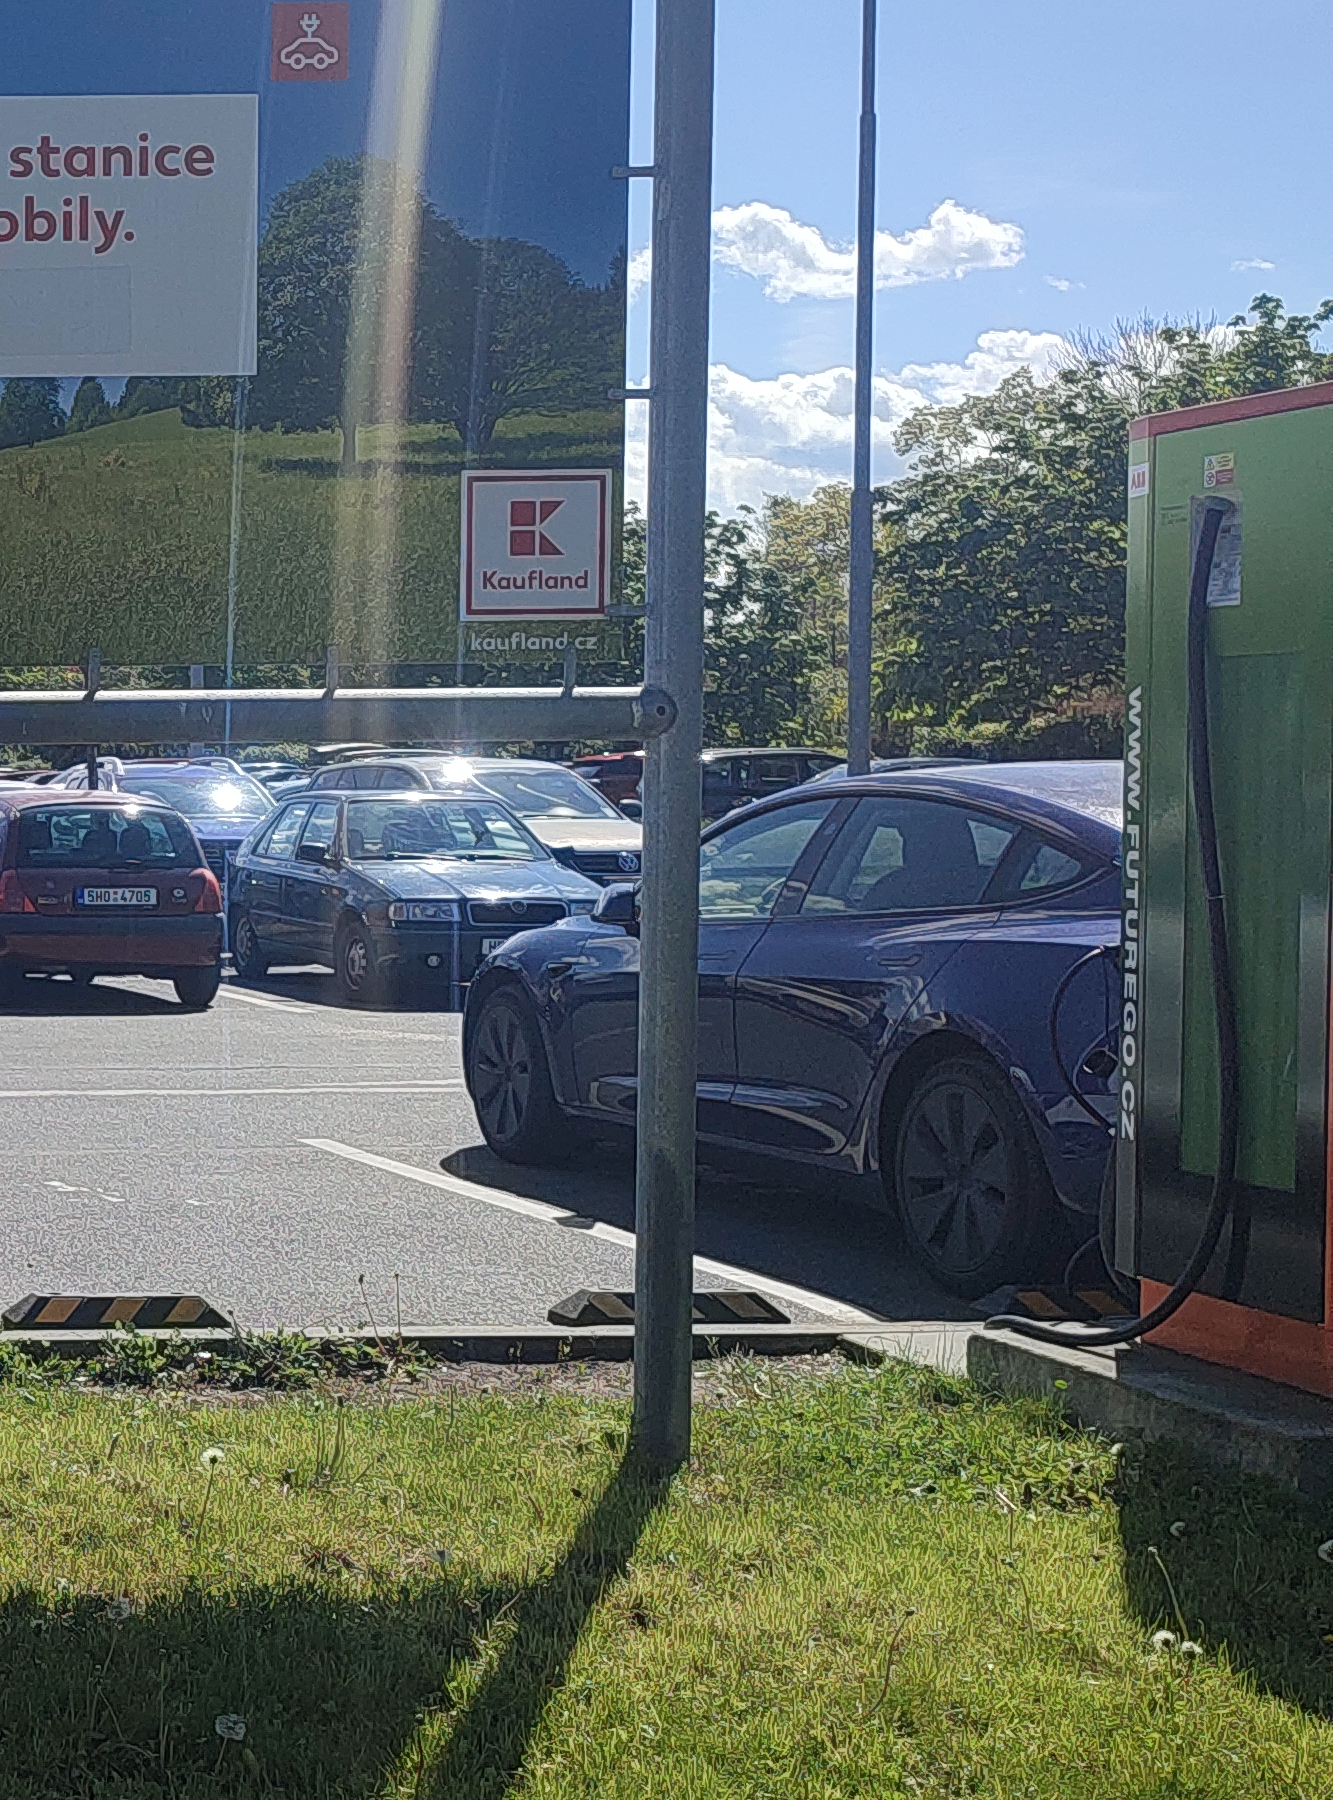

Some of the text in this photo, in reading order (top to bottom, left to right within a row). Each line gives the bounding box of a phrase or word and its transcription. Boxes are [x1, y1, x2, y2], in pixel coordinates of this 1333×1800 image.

[9, 132, 216, 179] stanice
[482, 569, 589, 590] Kaufland
[470, 632, 598, 651] kauflandcz
[1121, 685, 1142, 1142] WWW.FUTUREGO.CZ
